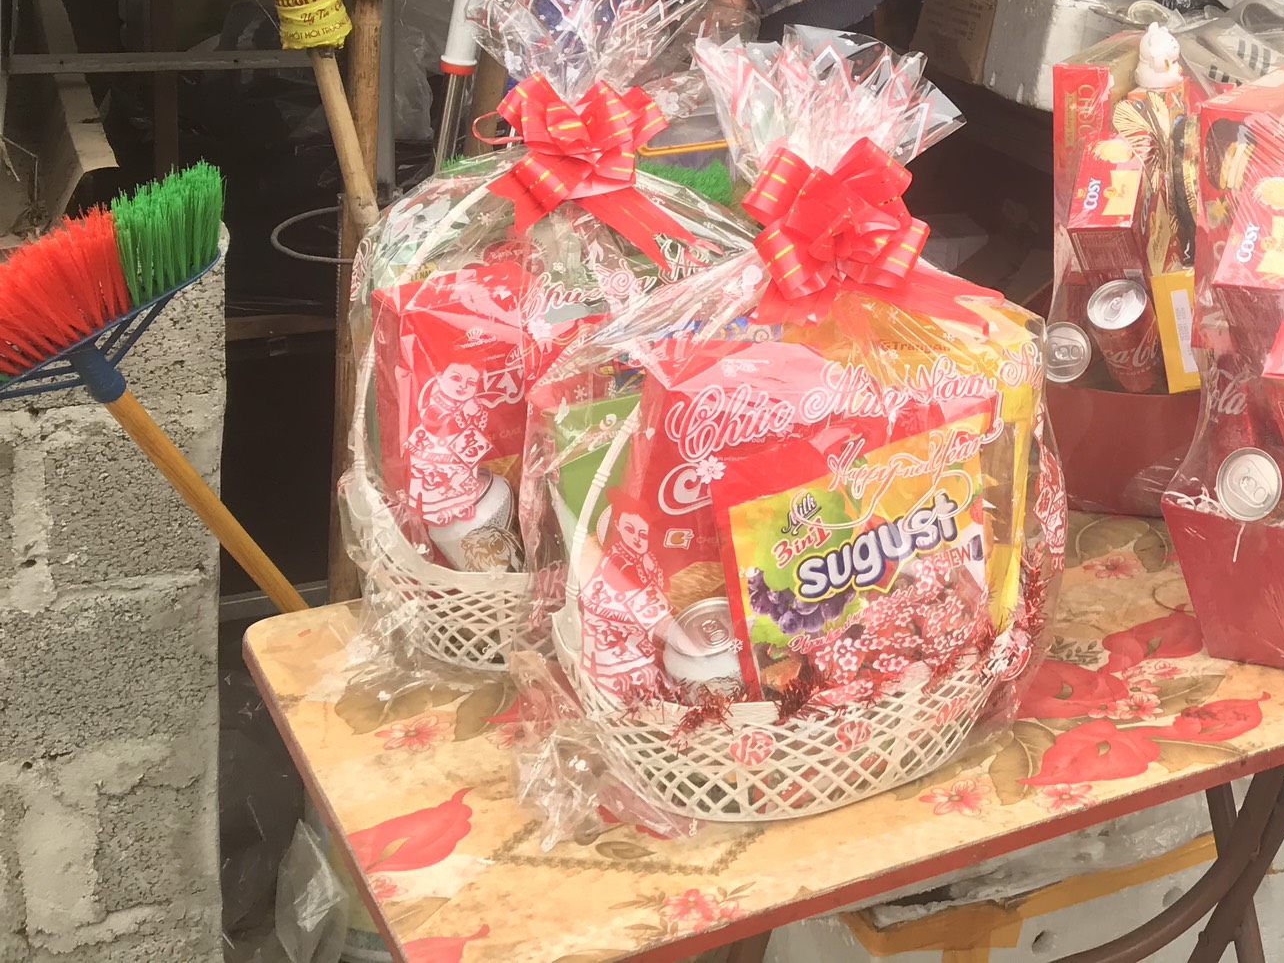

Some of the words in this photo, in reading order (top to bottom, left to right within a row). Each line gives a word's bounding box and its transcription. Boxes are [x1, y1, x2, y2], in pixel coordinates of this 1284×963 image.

[1082, 177, 1103, 211] COSY
[1235, 221, 1261, 264] COSY
[796, 492, 959, 599] sugust
